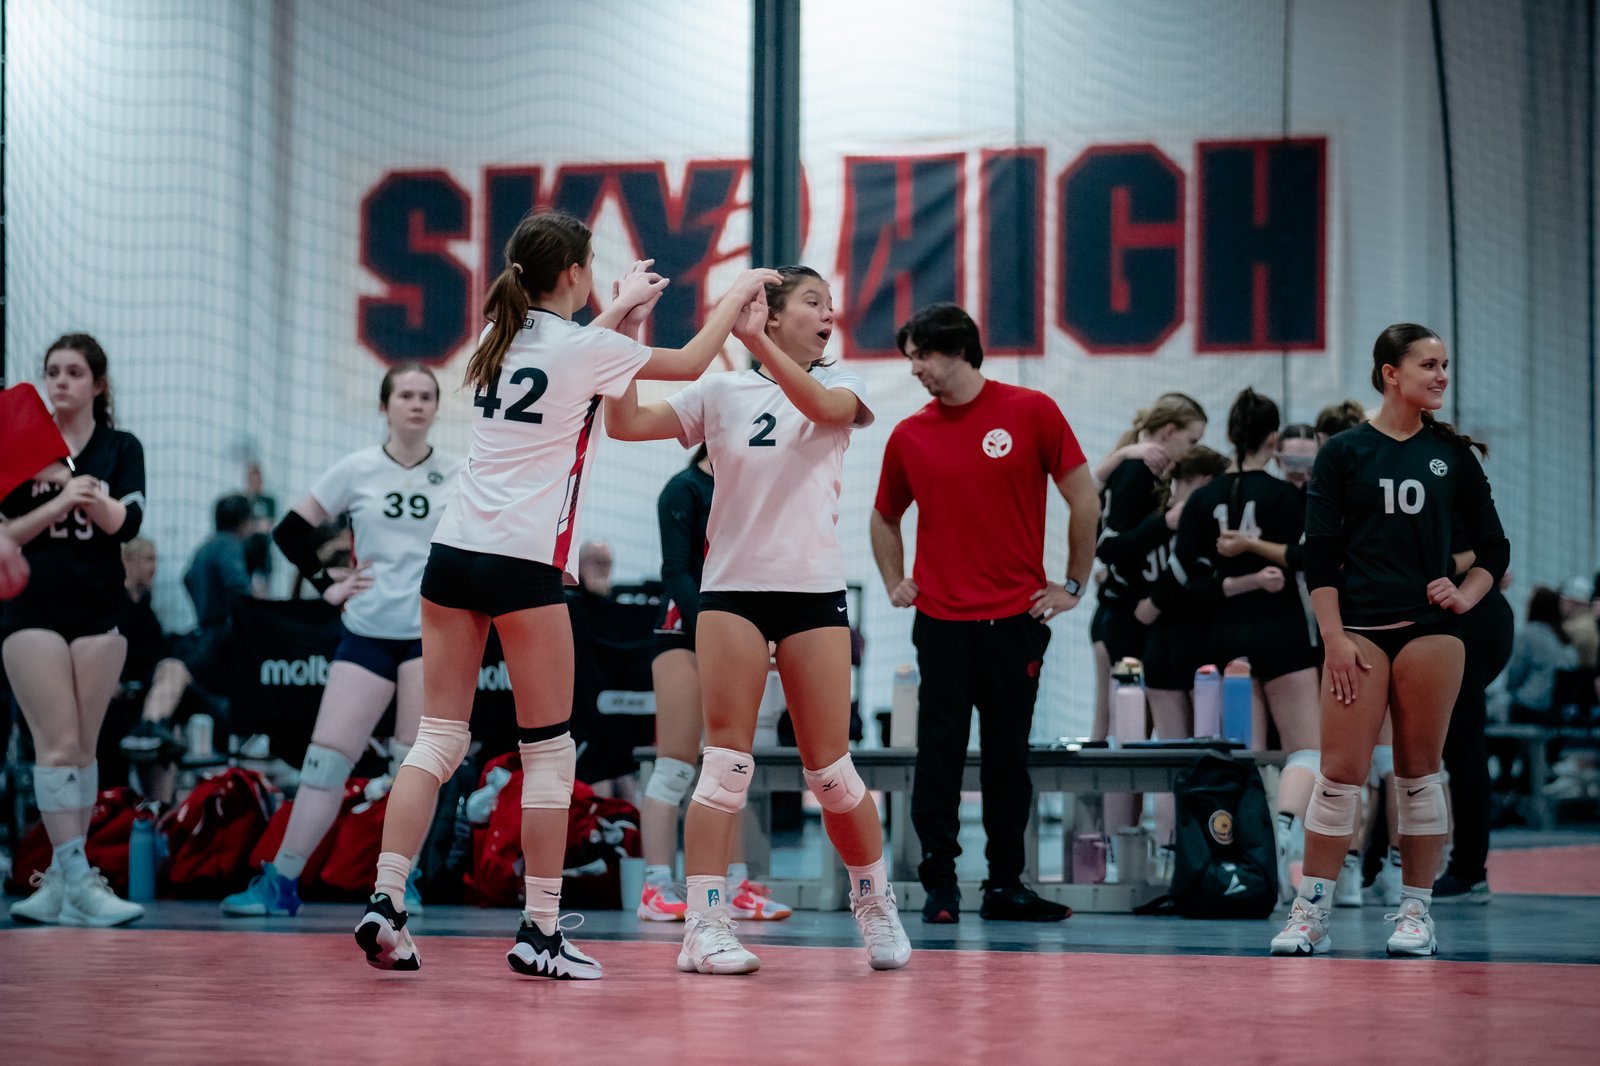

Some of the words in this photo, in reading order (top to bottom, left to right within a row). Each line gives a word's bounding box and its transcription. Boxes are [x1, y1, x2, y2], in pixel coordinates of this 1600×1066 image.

[357, 159, 752, 369] SKY
[838, 136, 1328, 359] HIGH
[473, 366, 549, 425] 42
[748, 412, 777, 447] 2
[383, 492, 430, 519] 39
[1379, 478, 1426, 515] 10
[1212, 500, 1263, 541] 14
[260, 654, 329, 686] molt
